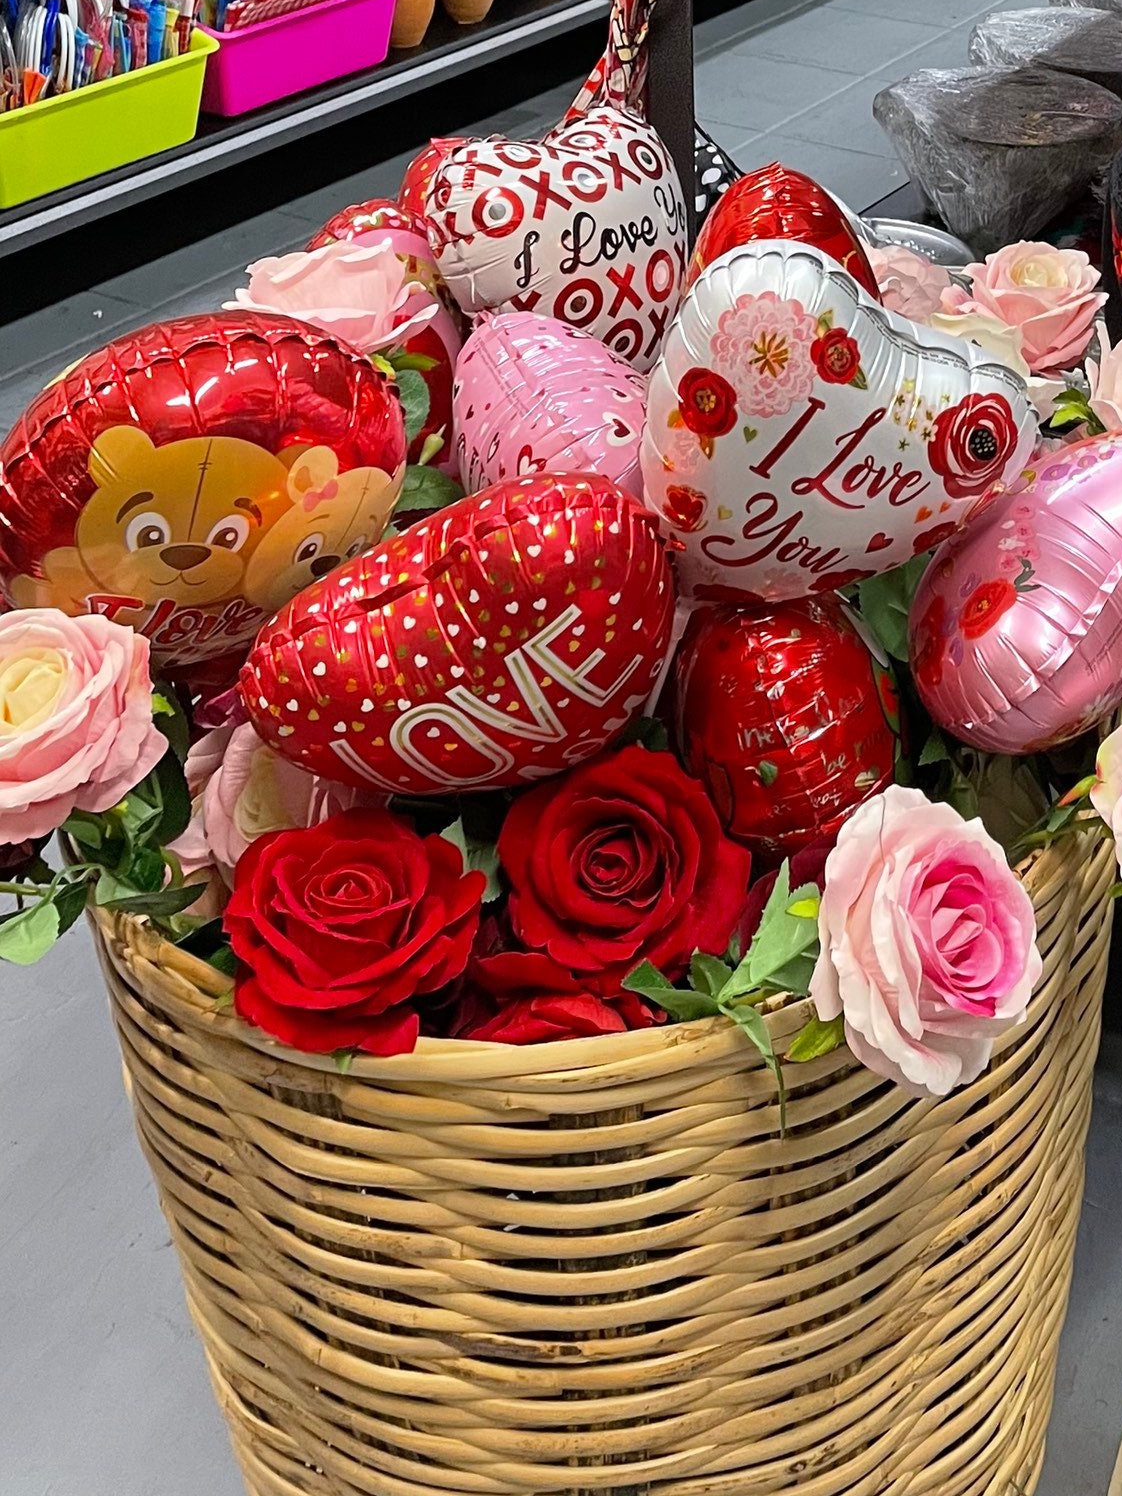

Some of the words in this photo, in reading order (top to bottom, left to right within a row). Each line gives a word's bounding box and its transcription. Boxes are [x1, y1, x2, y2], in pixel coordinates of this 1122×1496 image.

[514, 230, 540, 289] I
[559, 211, 657, 275] Love
[653, 185, 687, 236] Yo
[749, 397, 826, 479] I
[791, 407, 931, 509] Love
[700, 492, 849, 573] You
[328, 604, 644, 795] LOVE
